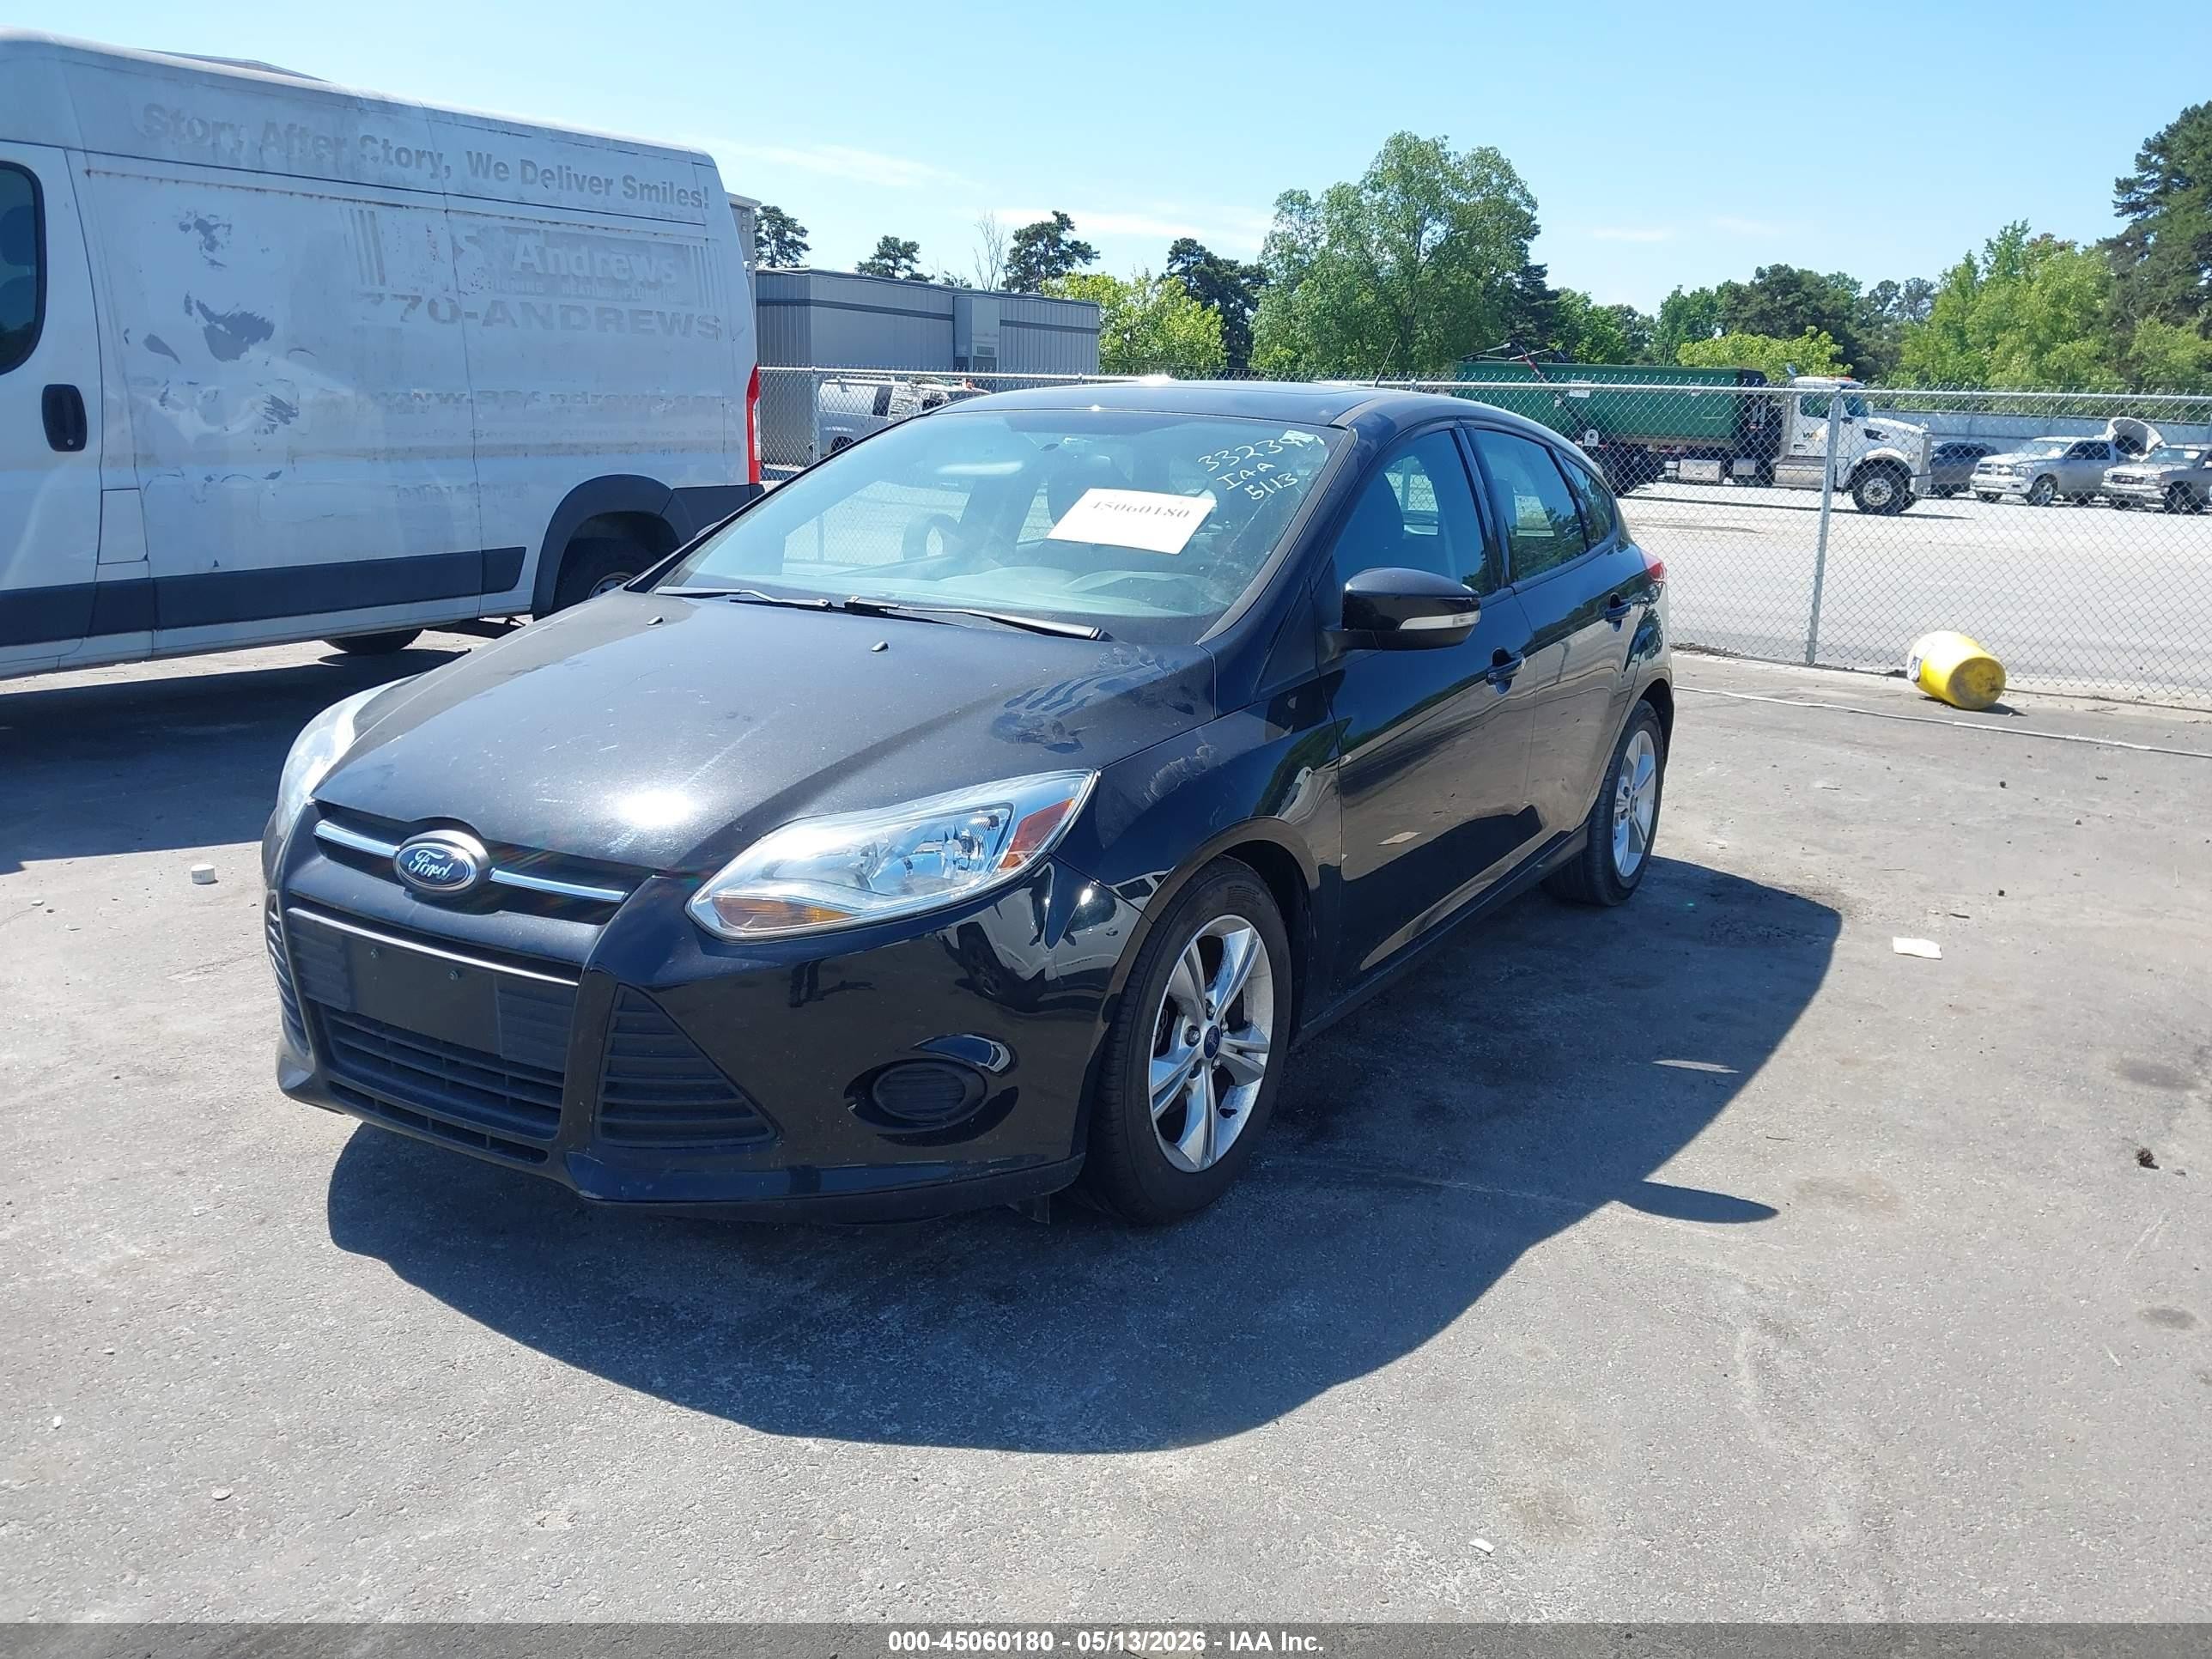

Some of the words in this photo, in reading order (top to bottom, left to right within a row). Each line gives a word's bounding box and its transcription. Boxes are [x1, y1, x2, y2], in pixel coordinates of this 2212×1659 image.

[258, 120, 348, 159] After
[465, 150, 510, 182] We
[520, 158, 616, 197] Deliver
[621, 174, 710, 210] Smiles!
[514, 232, 678, 283] Andrews
[1216, 462, 1276, 490] IAA
[409, 850, 453, 880] Ford
